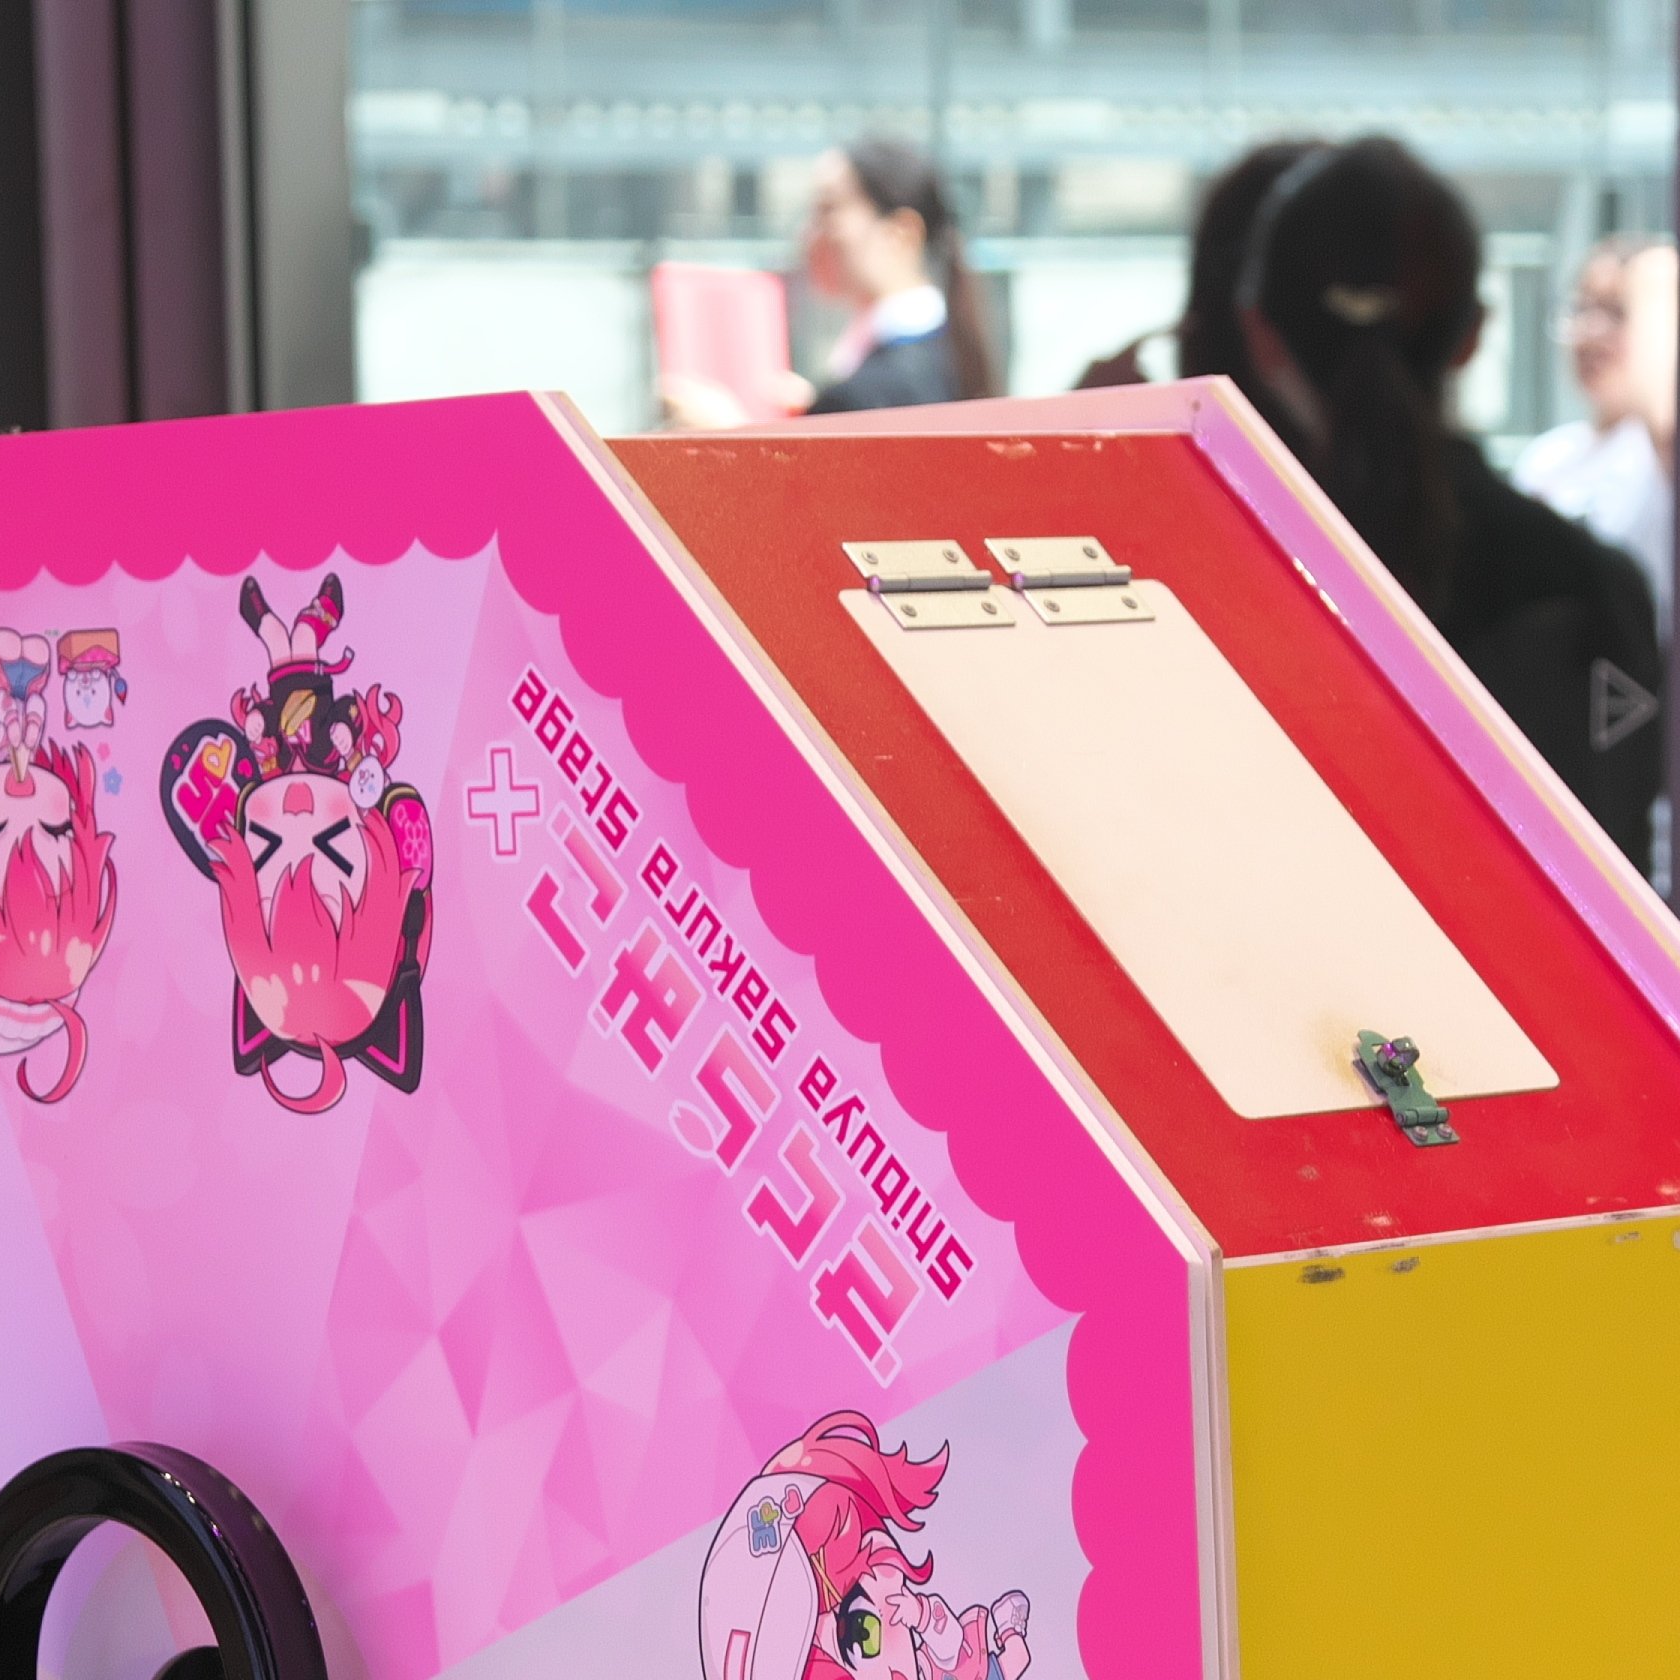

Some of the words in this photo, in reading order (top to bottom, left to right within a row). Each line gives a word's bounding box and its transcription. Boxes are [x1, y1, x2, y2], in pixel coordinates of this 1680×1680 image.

[513, 671, 638, 851] Stage
[641, 846, 796, 1062] Sakura
[800, 1057, 974, 1301] Shibuya
